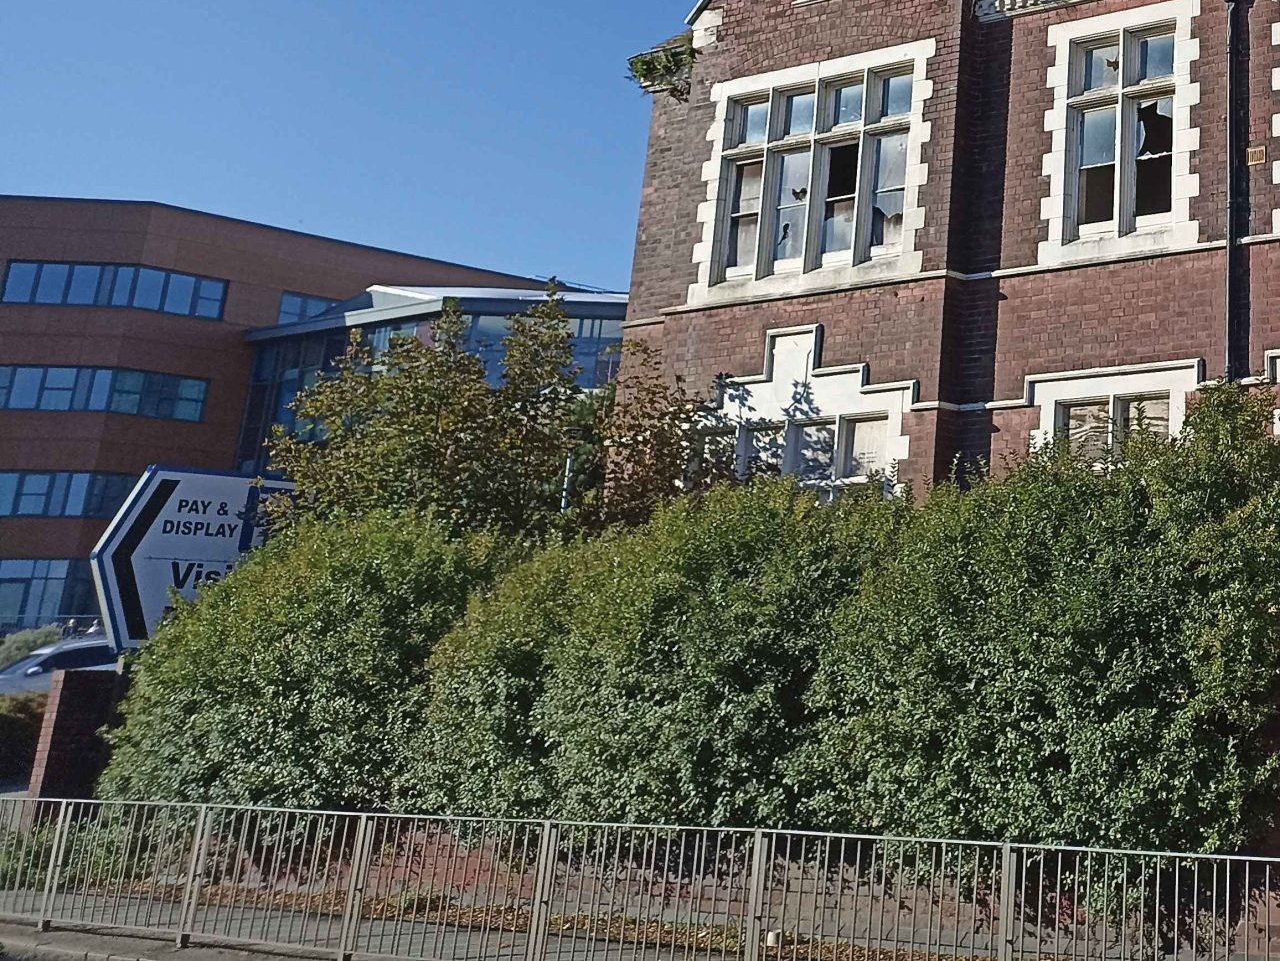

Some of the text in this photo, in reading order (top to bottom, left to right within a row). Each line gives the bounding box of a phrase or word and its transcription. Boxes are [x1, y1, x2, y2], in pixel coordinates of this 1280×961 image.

[177, 499, 229, 516] PAY &
[161, 519, 238, 538] DISPLAY
